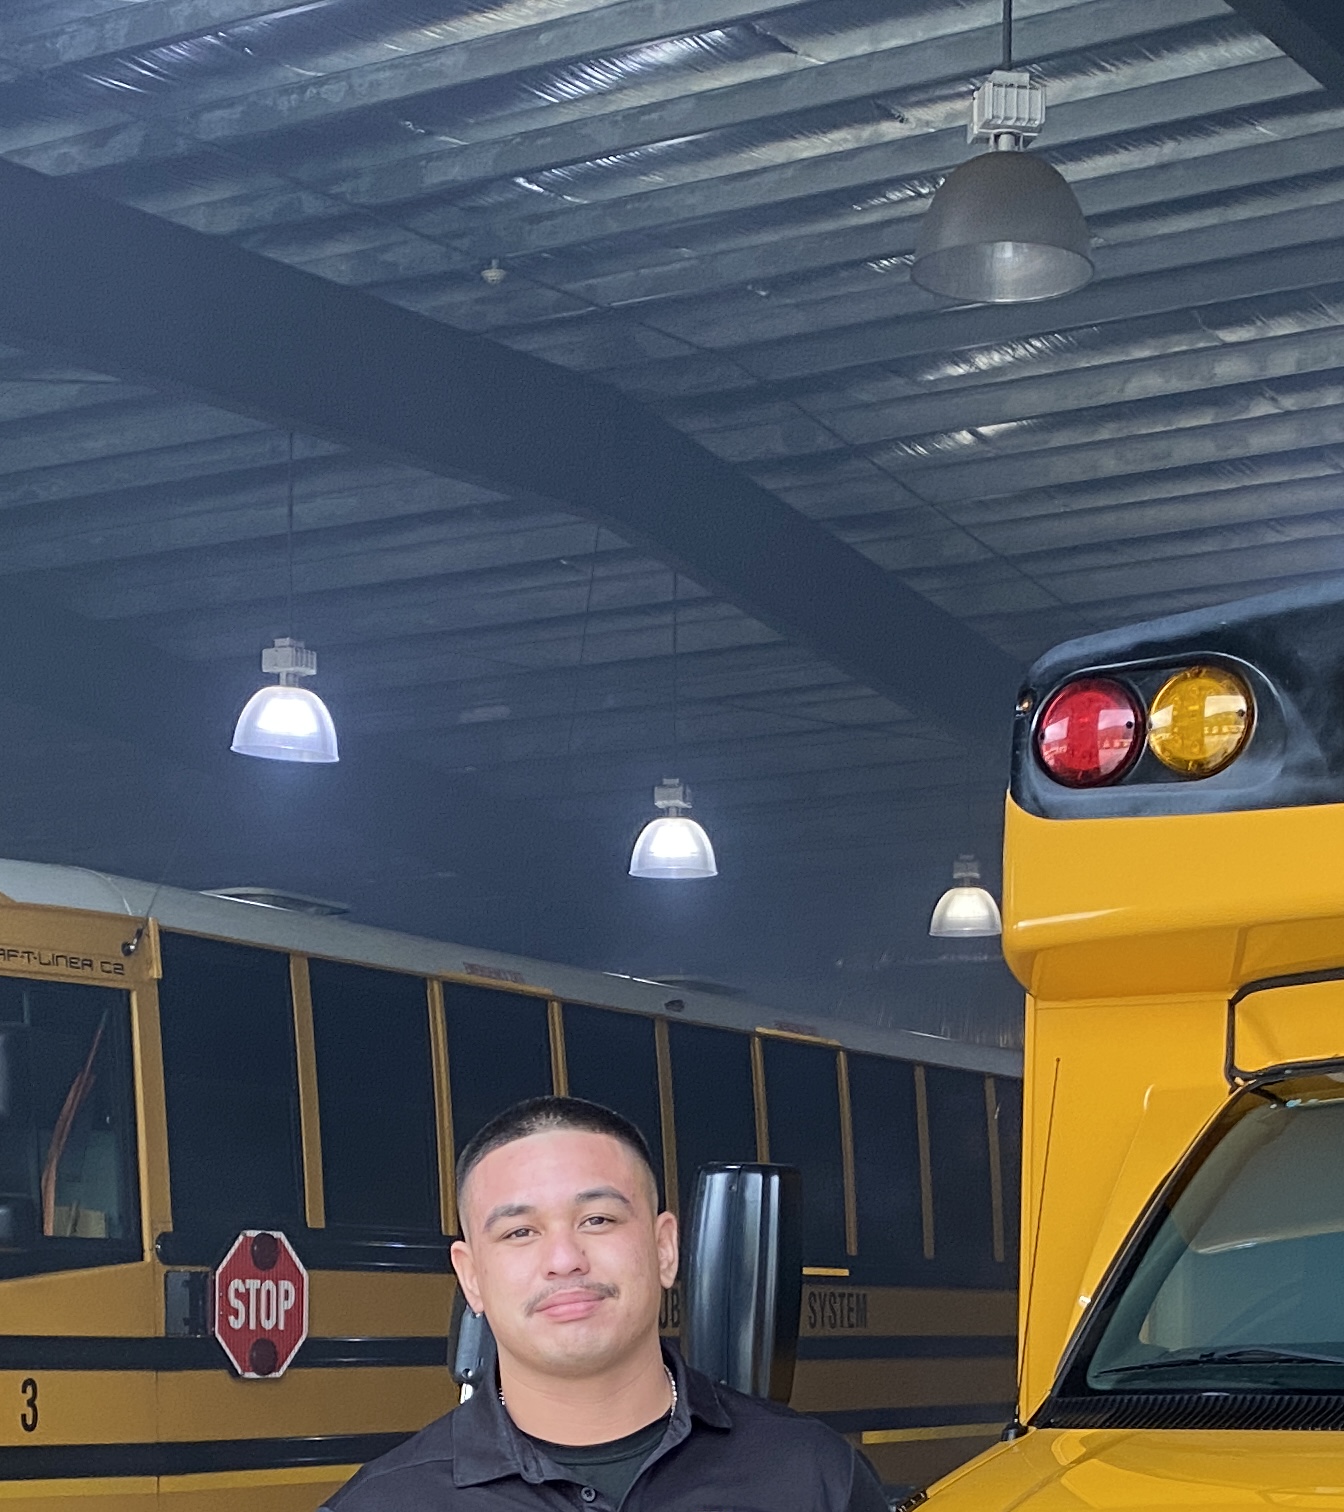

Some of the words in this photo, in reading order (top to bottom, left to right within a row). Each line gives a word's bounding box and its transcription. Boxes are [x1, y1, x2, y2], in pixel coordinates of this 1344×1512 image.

[99, 960, 126, 976] C2
[227, 1278, 296, 1331] STOP
[808, 1290, 868, 1329] SYSTEM
[21, 1377, 39, 1433] 3
